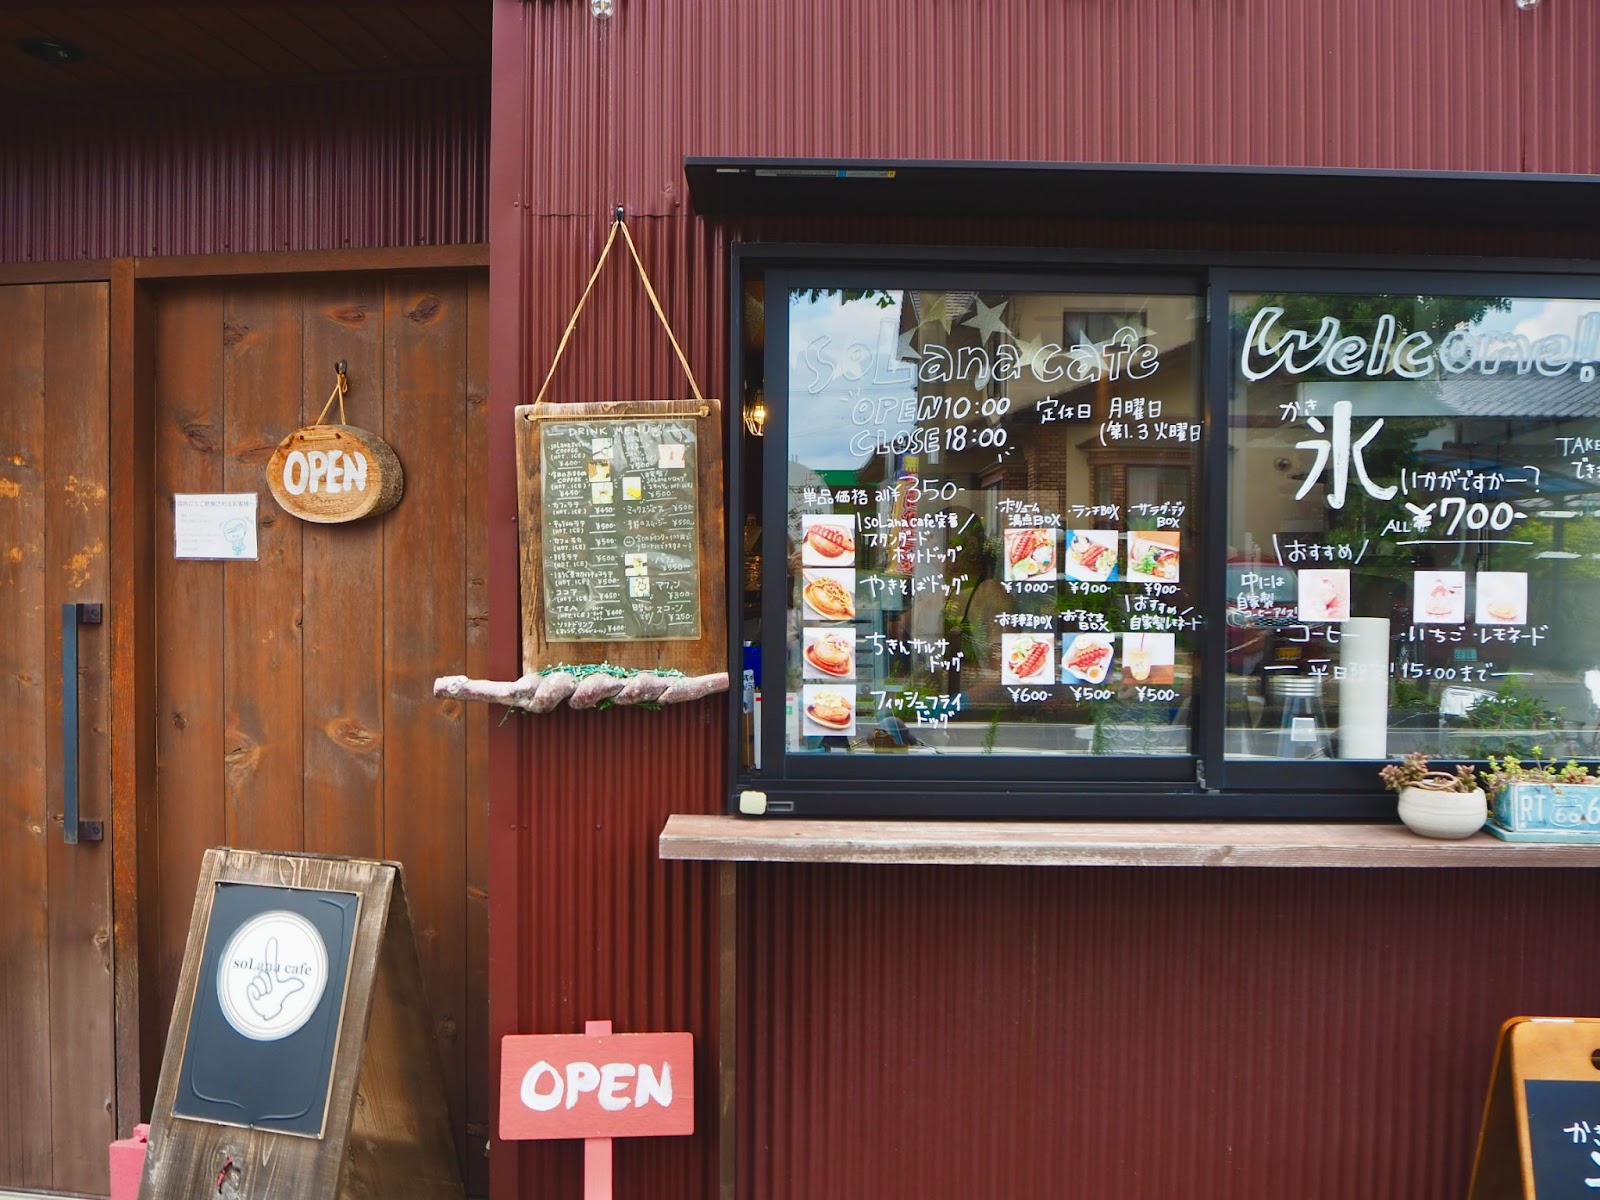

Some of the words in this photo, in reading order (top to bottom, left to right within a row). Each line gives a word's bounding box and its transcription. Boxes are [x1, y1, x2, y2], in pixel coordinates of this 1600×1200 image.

[1241, 306, 1600, 382] Welcome!
[1031, 326, 1160, 383] cafe
[852, 396, 944, 425] OPEN
[944, 396, 1010, 419] 10:00
[1036, 396, 1092, 424] 定休日
[1109, 397, 1162, 420] 月曜日
[1279, 399, 1318, 422] かき
[568, 427, 608, 437] DRINK
[615, 424, 650, 434] MENU
[849, 426, 941, 457] CLOSE
[945, 427, 1007, 451] 18:00
[1295, 400, 1398, 509] 氷
[283, 450, 367, 495] OPEN
[803, 487, 869, 507] 単品価格
[1157, 517, 1180, 528] BOX
[1380, 519, 1411, 537] ALL
[892, 545, 962, 564] ホットドッグ
[1287, 540, 1353, 562] おすすめ
[859, 573, 969, 598] やきそばドッグ
[1240, 570, 1286, 593] 中には
[556, 588, 578, 596] ココア
[1237, 591, 1276, 611] 自家製
[656, 604, 684, 614] スコーン
[1133, 595, 1177, 615] おすすめ
[997, 611, 1053, 630] お手軽BOX
[1060, 609, 1104, 622] お子さま
[1130, 615, 1203, 631] 自家製レモネード
[1078, 622, 1110, 632] BOX
[1288, 625, 1360, 643] コーヒー
[1408, 626, 1466, 643] いちご
[1480, 624, 1549, 646] レモネード
[865, 631, 950, 655] ちきんサルサ
[929, 652, 964, 673] ドッグ
[870, 690, 962, 712] フィッシュフライ
[917, 710, 955, 729] ドッグ
[1520, 795, 1547, 821] RT
[1555, 808, 1579, 823] 66
[233, 958, 280, 973] soLana
[285, 963, 312, 976] cafe
[520, 1060, 673, 1111] OPEN
